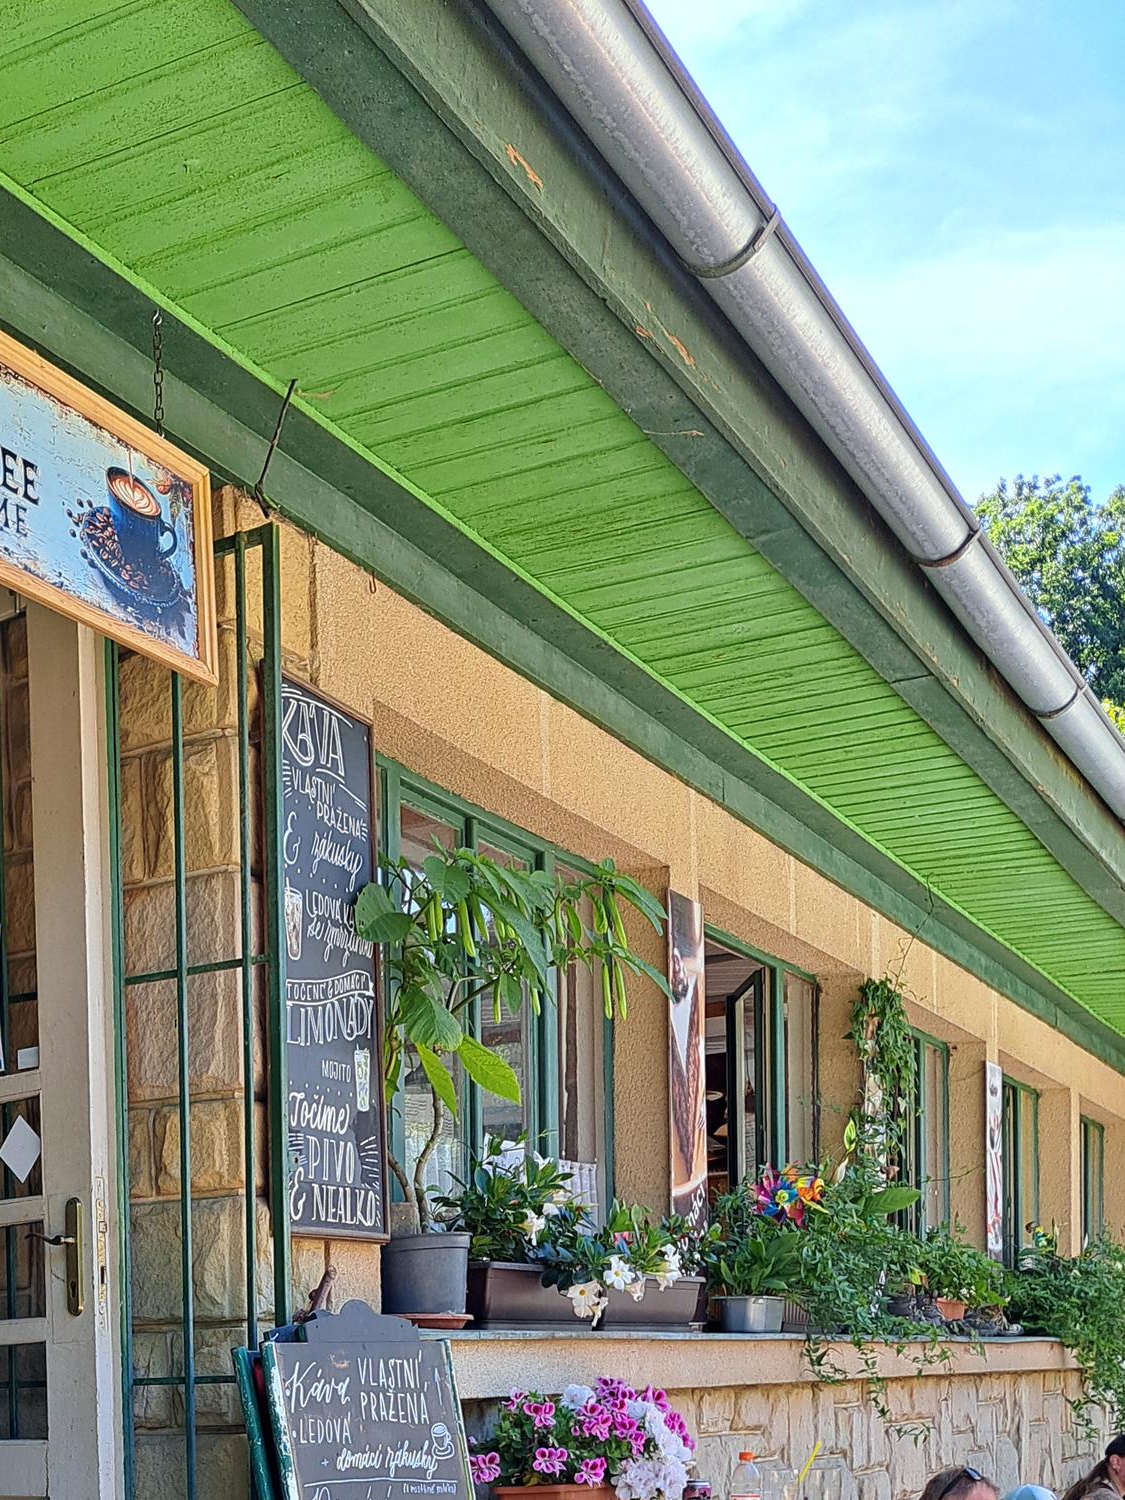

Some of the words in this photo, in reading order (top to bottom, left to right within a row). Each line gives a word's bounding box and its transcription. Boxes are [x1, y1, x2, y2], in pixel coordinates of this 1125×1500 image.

[292, 767, 336, 805] VLASTNÍ
[316, 803, 363, 840] PRAŽENÁ
[283, 811, 301, 865] &
[311, 830, 364, 892] zákusky
[305, 888, 342, 924] LEDOVÁ
[286, 993, 374, 1046] LIMONÁDY
[322, 1059, 351, 1083] MOJITO
[306, 1135, 354, 1184] PIVO
[290, 1167, 306, 1221] &
[312, 1184, 375, 1227] NEALKO
[286, 1361, 351, 1413] Káva
[360, 1387, 430, 1425] PRAŽENÁ
[299, 1411, 352, 1444] LEDOVÁ
[336, 1443, 383, 1471] domácí
[385, 1440, 437, 1479] zákusky
